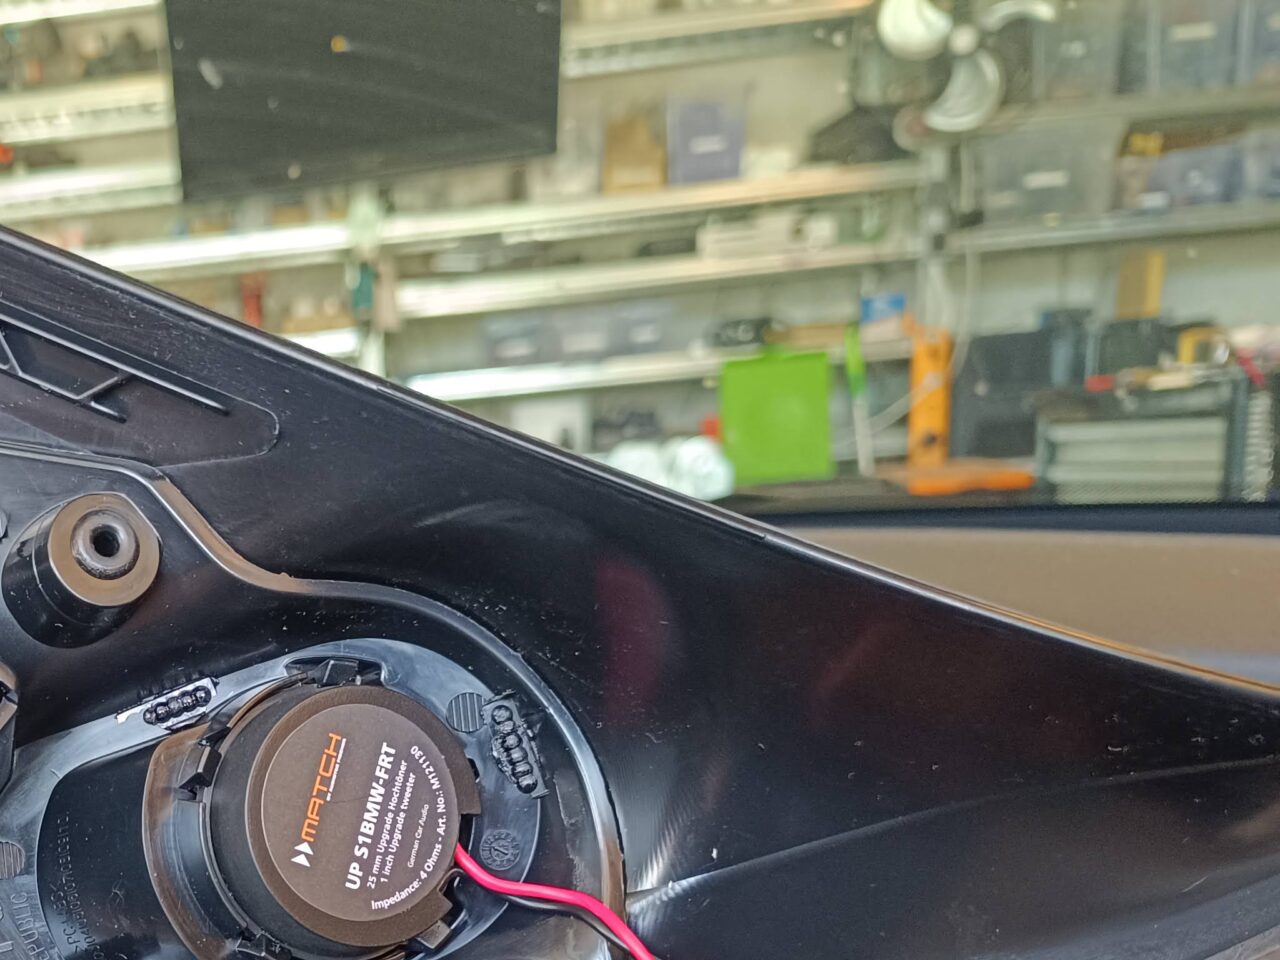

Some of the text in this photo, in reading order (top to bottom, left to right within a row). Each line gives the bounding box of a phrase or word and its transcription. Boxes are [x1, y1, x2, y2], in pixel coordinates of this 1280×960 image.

[300, 732, 342, 843] MATCH
[410, 745, 442, 791] M121130
[400, 772, 417, 812] tweeter
[345, 741, 396, 891] UP S1BMW-FRT
[366, 759, 408, 889] 25 mm Upgrade Hochtöner
[388, 811, 407, 853] Upgrade
[407, 804, 430, 869] German Car Audio
[438, 815, 447, 836] Art.
[384, 855, 395, 877] inch
[420, 869, 428, 880] 4
[426, 843, 443, 872] Ohms
[371, 878, 422, 911] Impedance:
